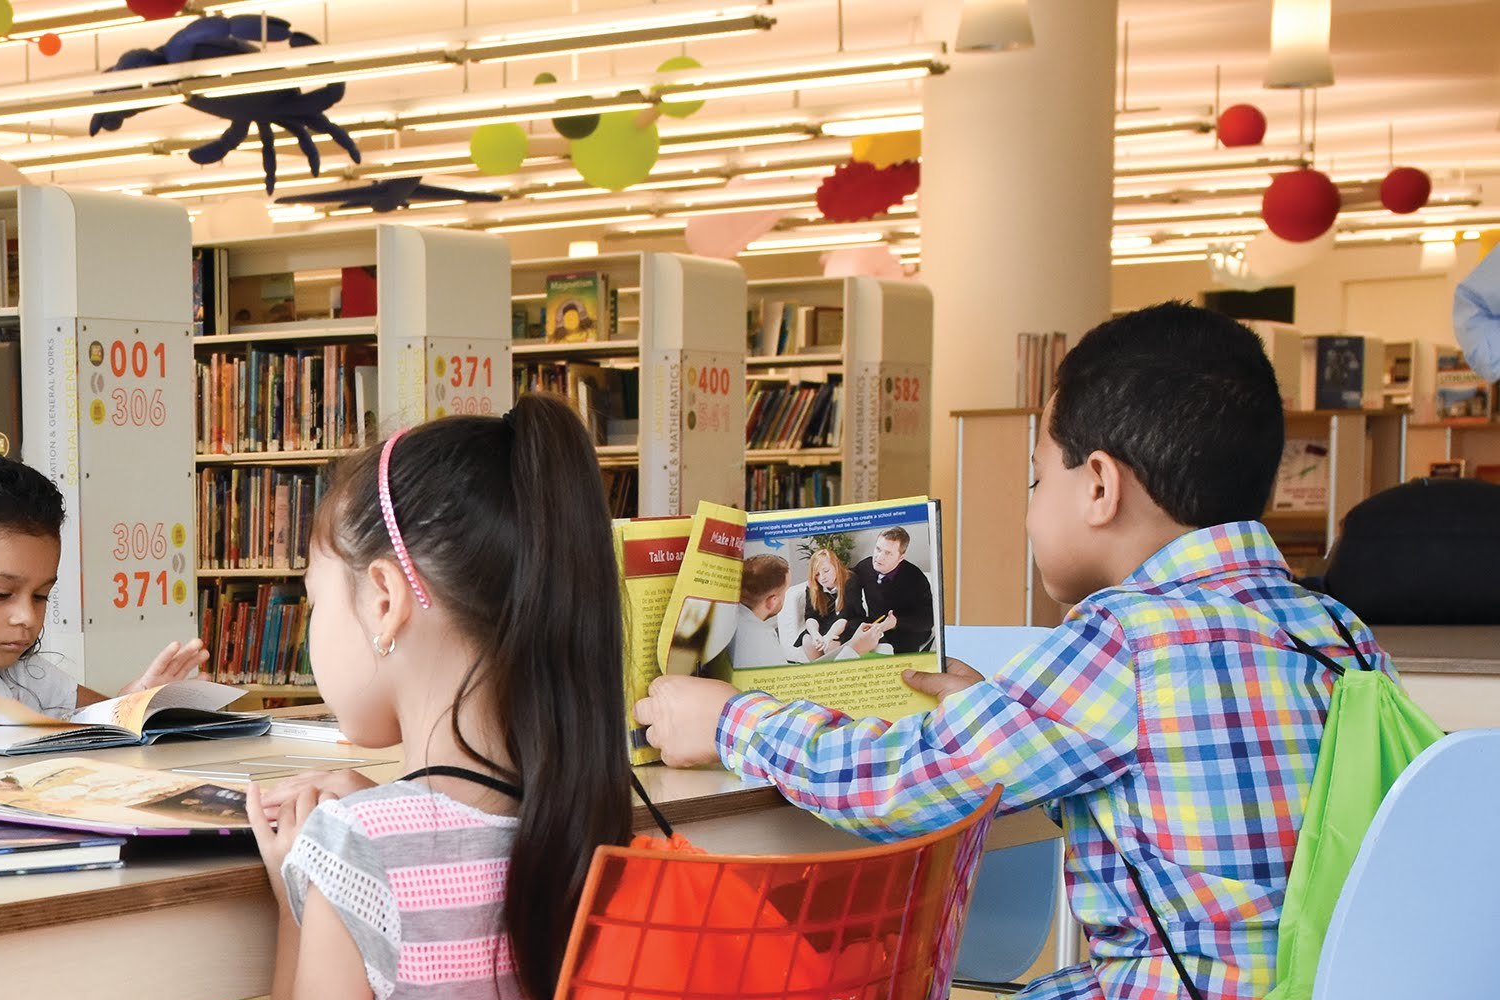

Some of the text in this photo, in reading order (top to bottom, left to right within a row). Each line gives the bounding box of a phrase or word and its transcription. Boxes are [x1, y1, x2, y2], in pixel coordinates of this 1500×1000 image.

[110, 340, 167, 379] 001
[450, 355, 492, 388] 371
[698, 367, 730, 395] 400
[894, 376, 920, 402] 582
[64, 336, 78, 487] SOCIAL SCIENCES
[111, 388, 167, 426] 306
[50, 430, 56, 440] &
[669, 363, 679, 516] CIENCE & MATHEMATICS
[855, 471, 863, 500] ENCE
[868, 471, 876, 500] ENCE
[112, 522, 168, 561] 306
[710, 531, 729, 546] Make
[735, 536, 744, 551] Rig
[760, 524, 780, 532] principals
[649, 550, 665, 562] Talk
[666, 551, 674, 561] to
[112, 570, 168, 609] 371
